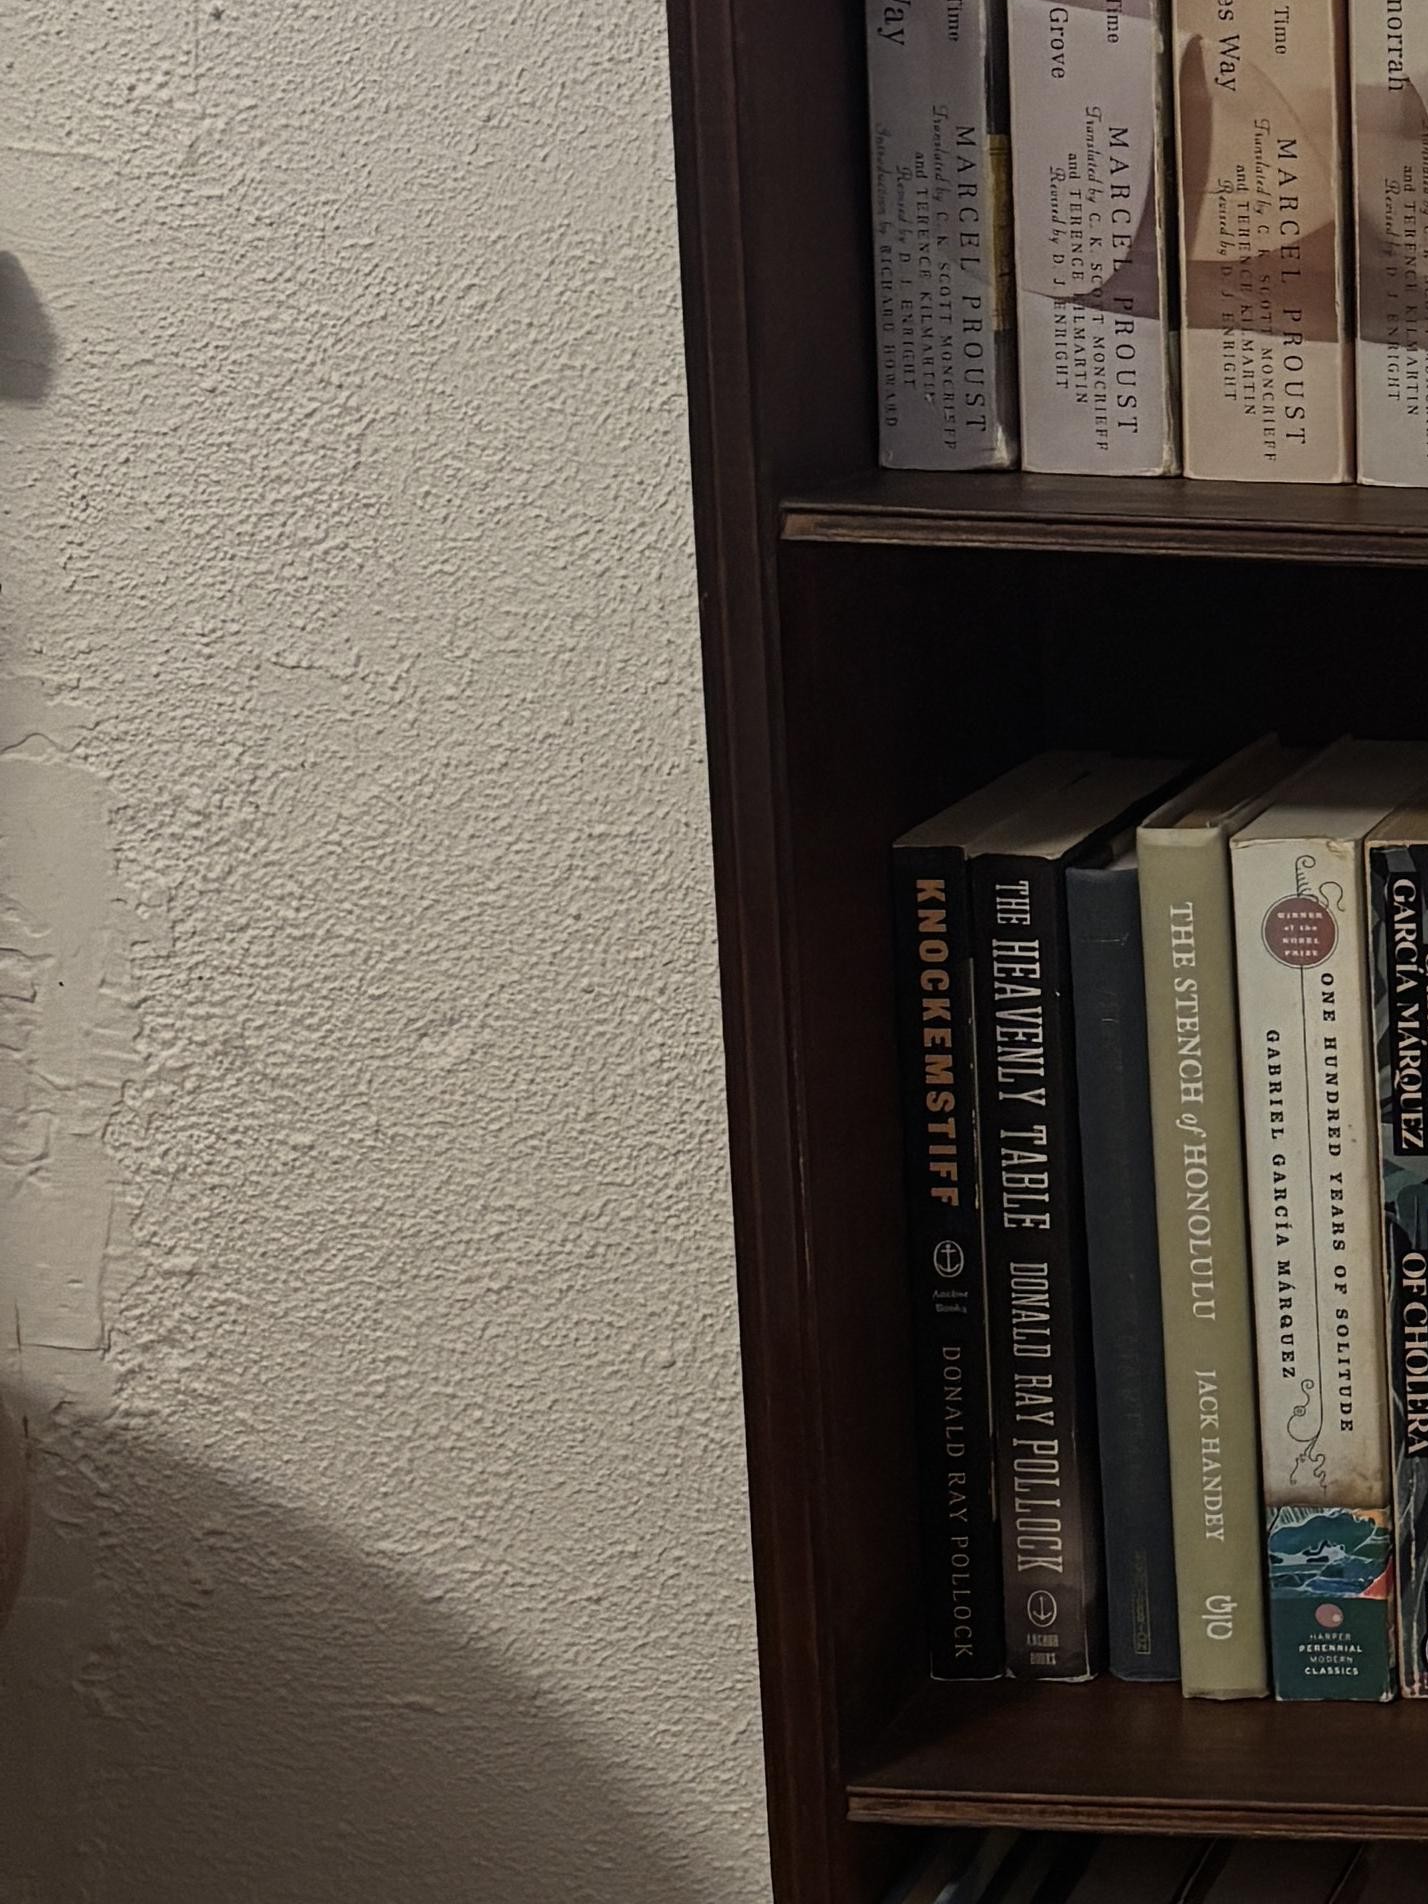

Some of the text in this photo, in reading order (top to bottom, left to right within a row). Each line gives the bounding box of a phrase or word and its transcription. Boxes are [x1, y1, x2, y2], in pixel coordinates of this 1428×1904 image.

[1215, 35, 1241, 92] Way
[956, 126, 986, 434] MARCEL PROUST
[915, 879, 960, 1208] KNOCKEMSTIFF
[992, 880, 1050, 1230] THE HEAVENLY TABLE
[1320, 973, 1354, 1433] ONE HUNDRED YEARS OF SOLITUDE
[1169, 902, 1224, 1542] THE STENCH of HONOLULU JACK HANDEY
